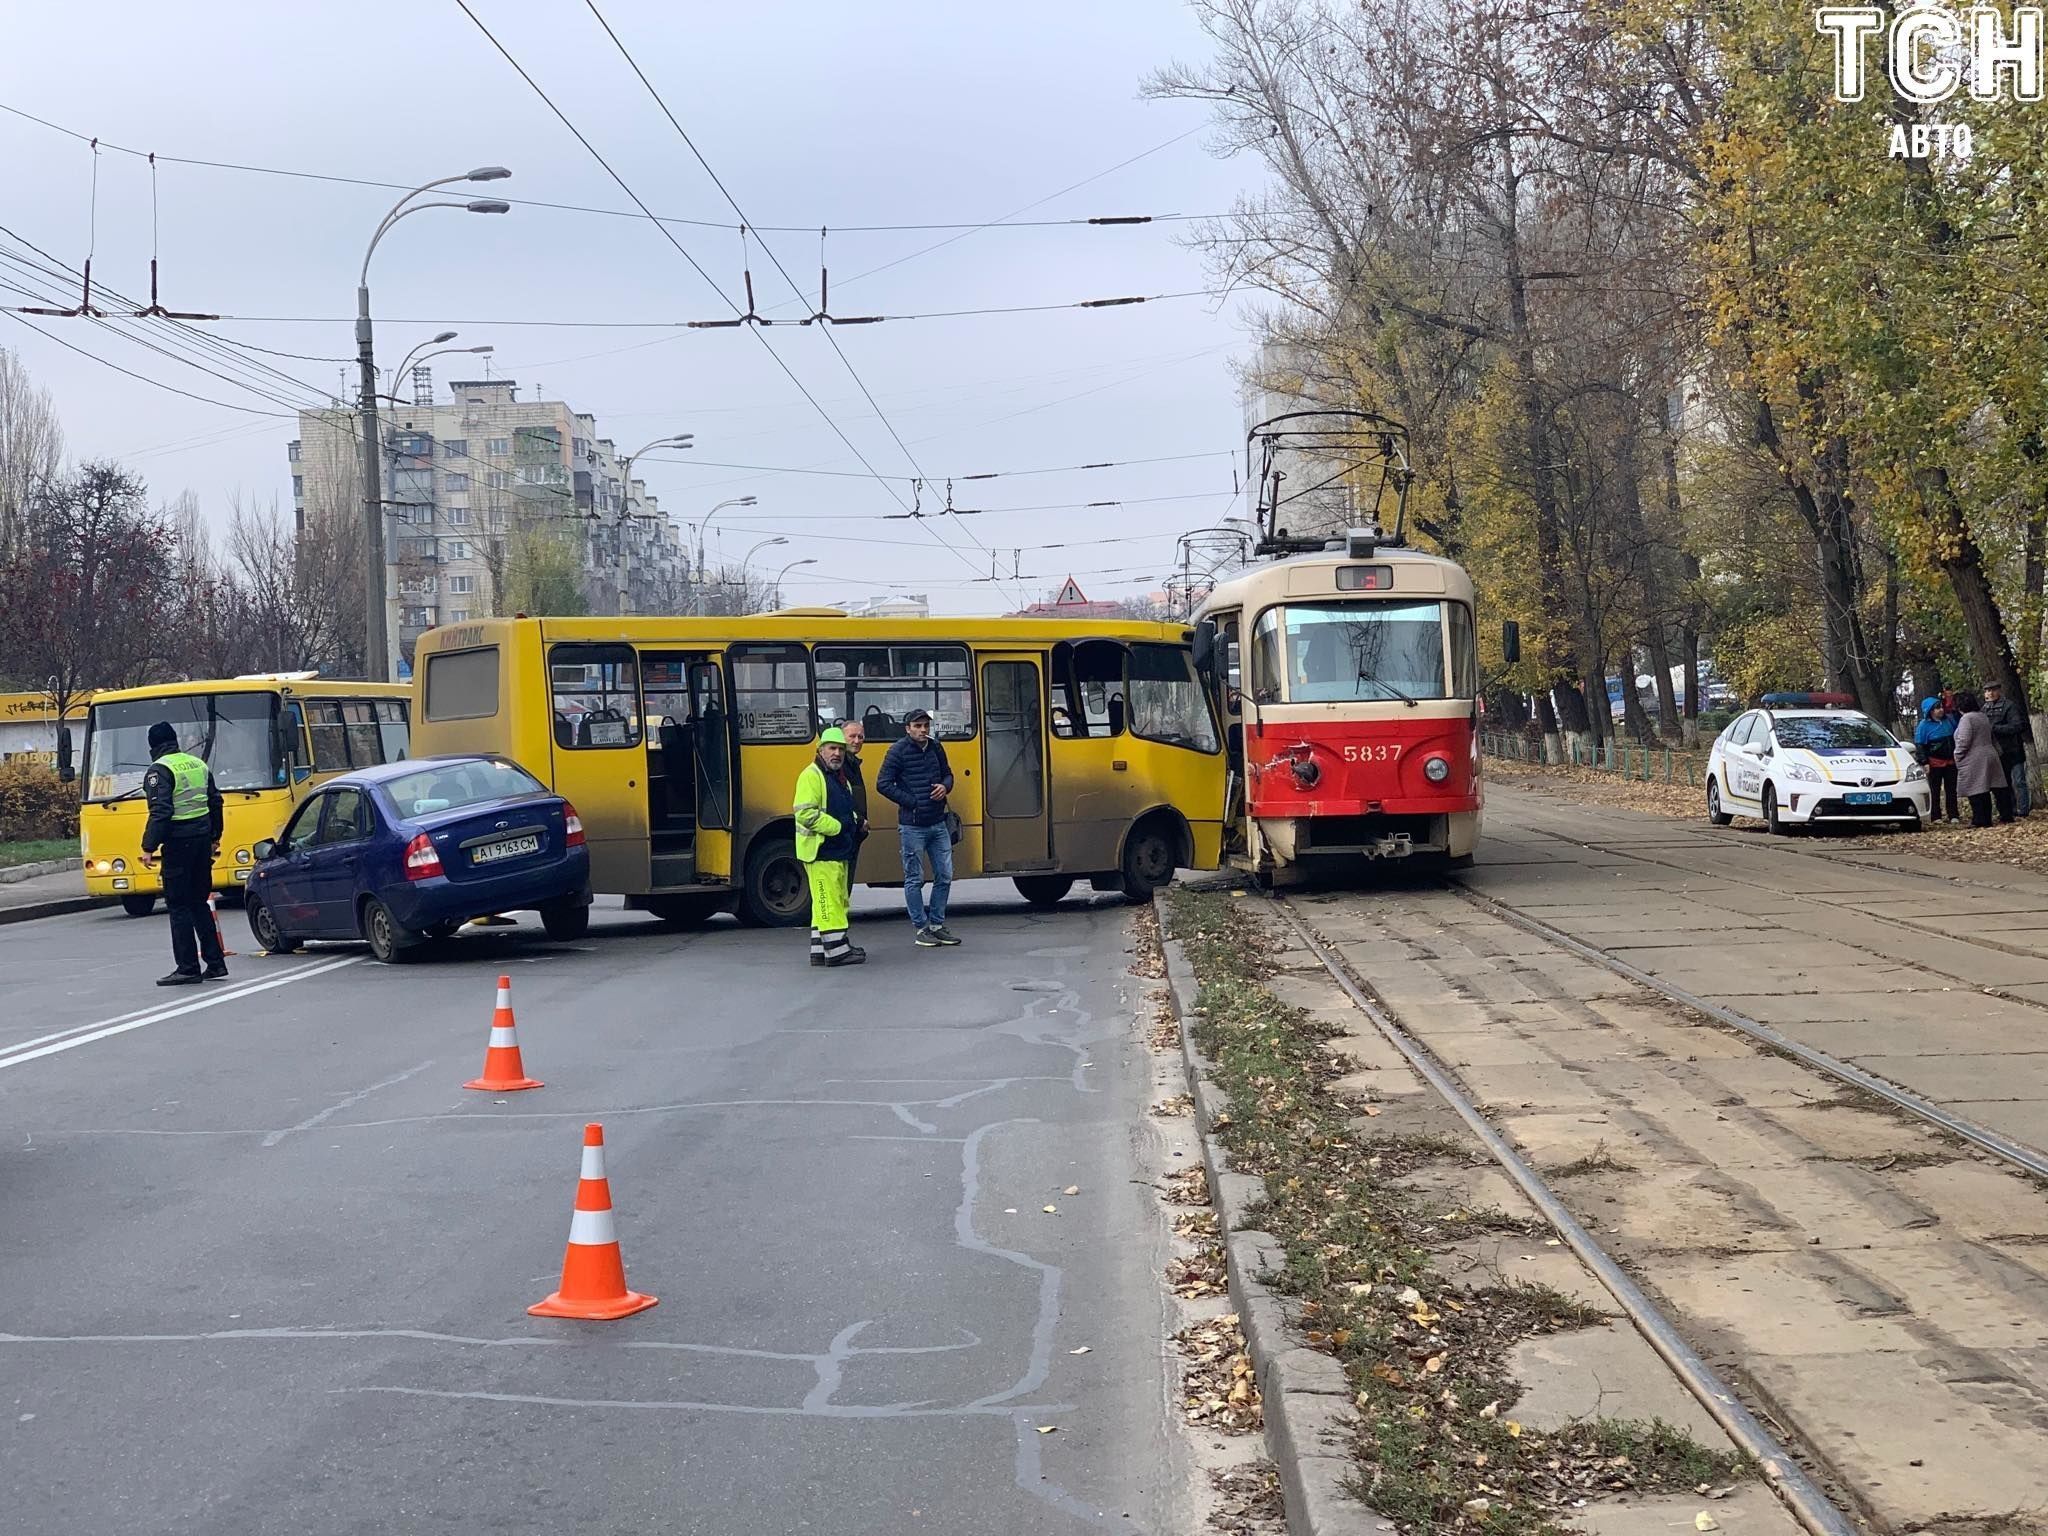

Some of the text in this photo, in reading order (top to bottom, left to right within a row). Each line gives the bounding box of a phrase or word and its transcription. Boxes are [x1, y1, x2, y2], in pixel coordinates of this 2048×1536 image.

[738, 712, 755, 729] 219
[1343, 744, 1402, 762] 5837
[1830, 758, 1887, 766] ПОЛІЦІЯ
[93, 776, 112, 797] 227
[495, 840, 519, 855] 9163
